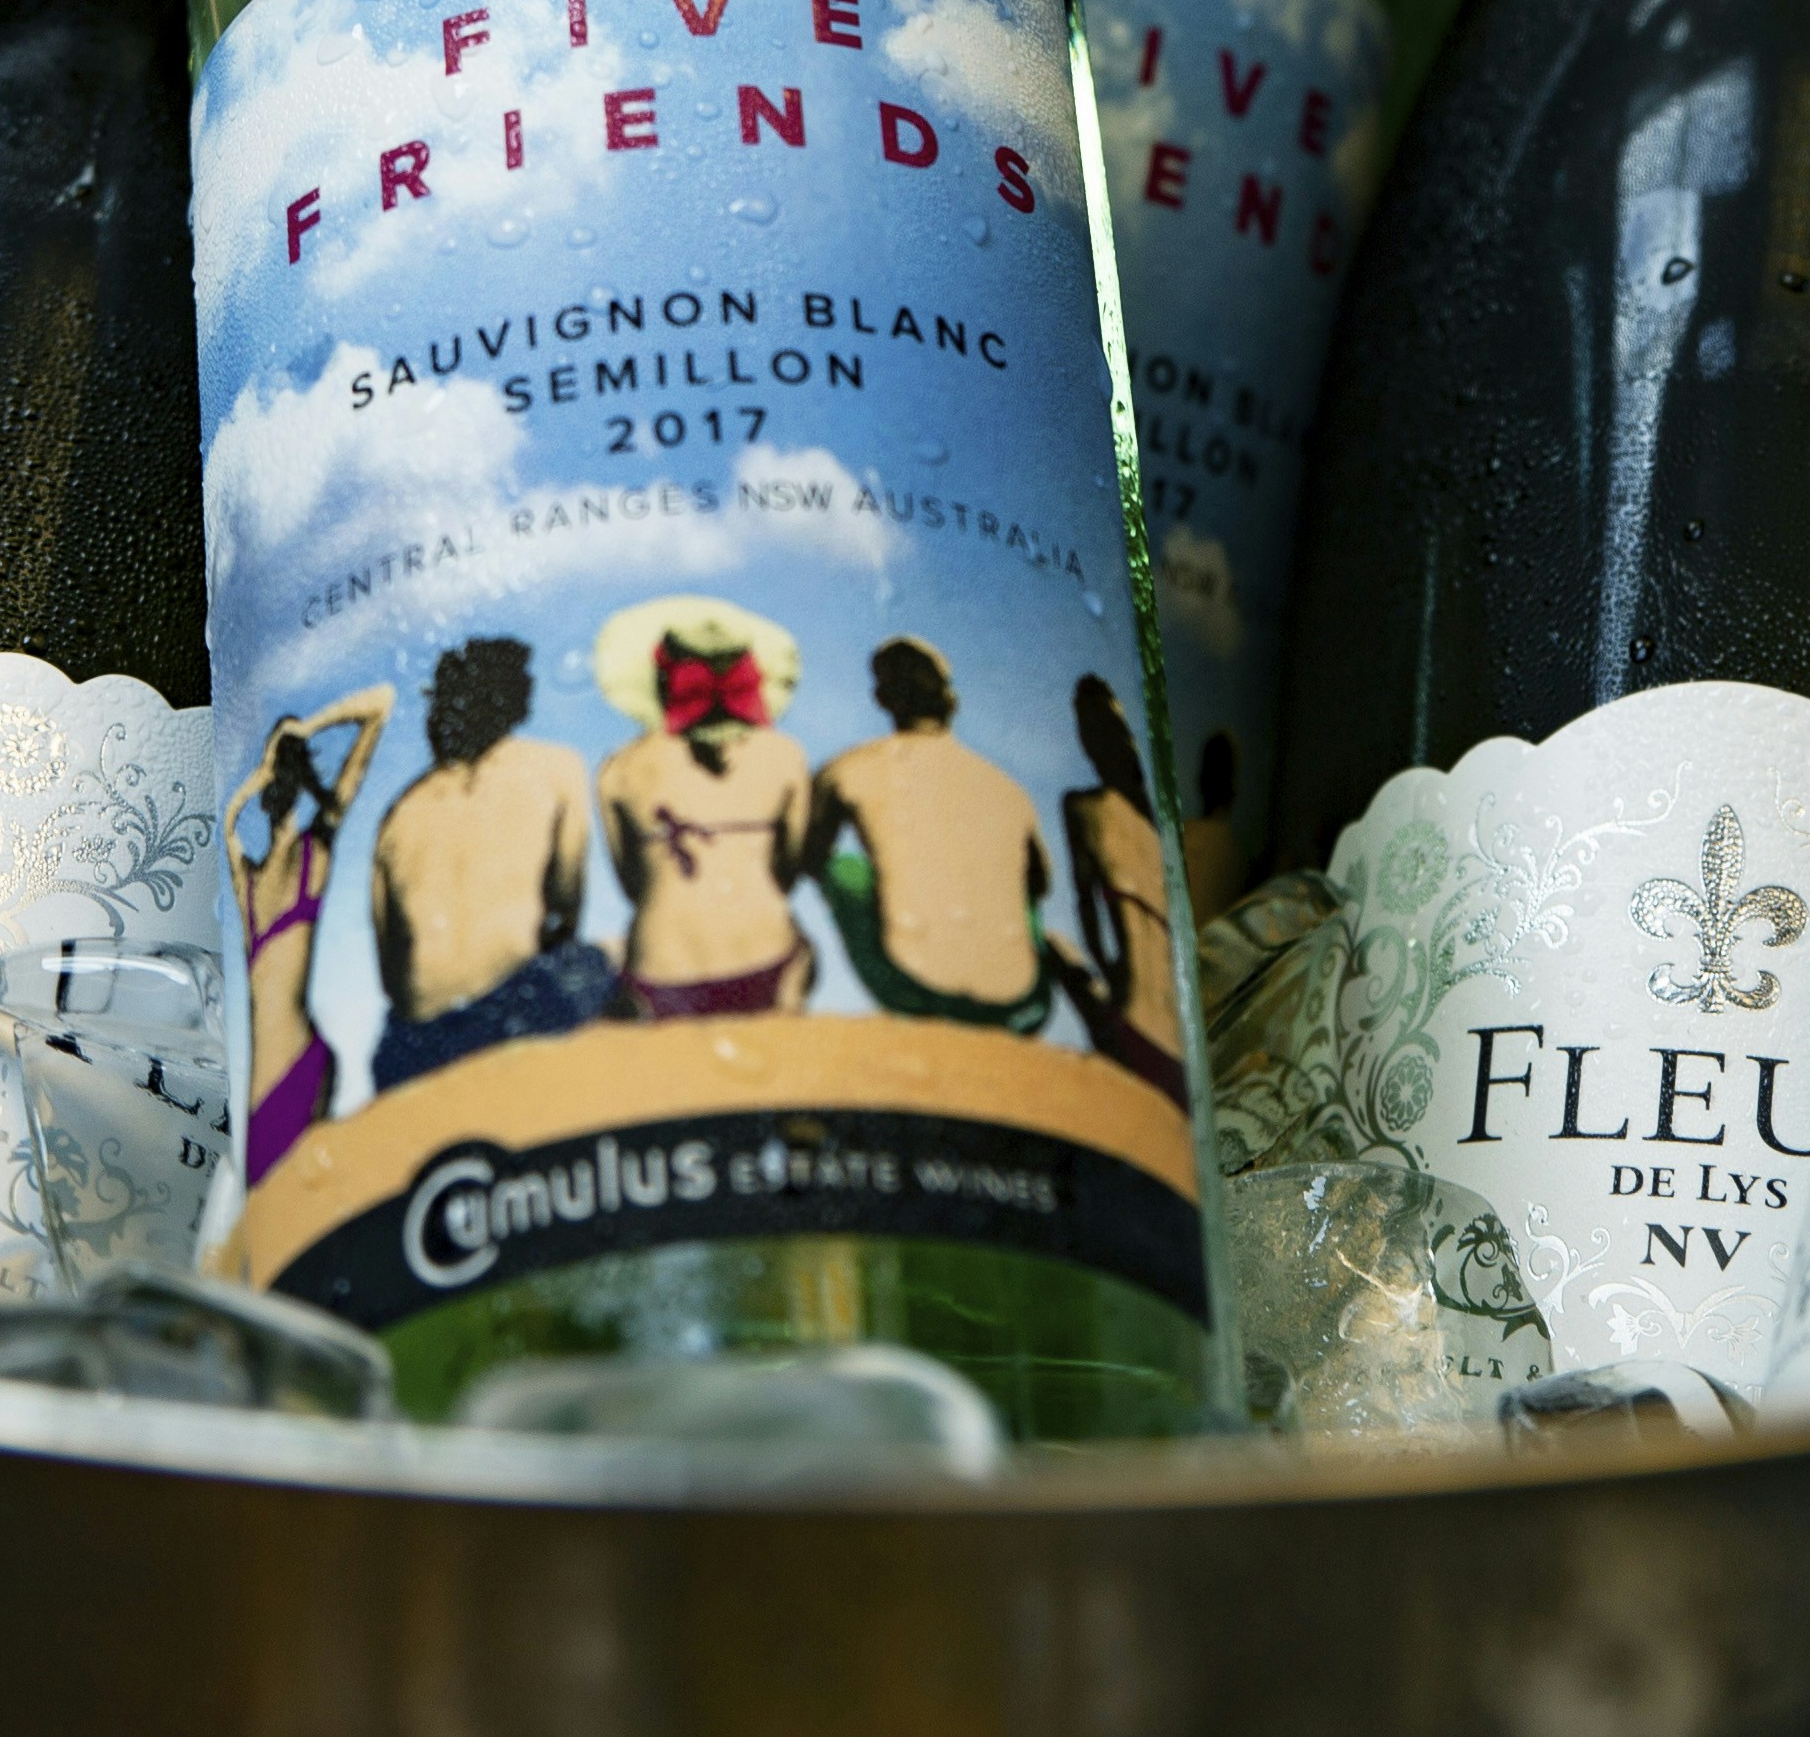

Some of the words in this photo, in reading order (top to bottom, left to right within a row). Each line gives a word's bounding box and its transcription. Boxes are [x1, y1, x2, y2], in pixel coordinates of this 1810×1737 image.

[1140, 27, 1330, 156] IVE
[285, 85, 1037, 266] FRIENDS
[352, 291, 757, 411] SAUVIGNON
[803, 291, 1008, 370] BLANC
[505, 348, 866, 415] SEMILLON
[605, 408, 769, 454] 2017
[302, 528, 487, 629] CENTRAL
[510, 481, 720, 539] RANGES
[738, 480, 835, 513] NSW
[852, 487, 1084, 581] AUSTRALIA
[402, 1137, 716, 1290] Cumulus
[914, 1159, 1057, 1214] WINES
[1611, 1165, 1676, 1199] DE
[1639, 1223, 1752, 1272] NV
